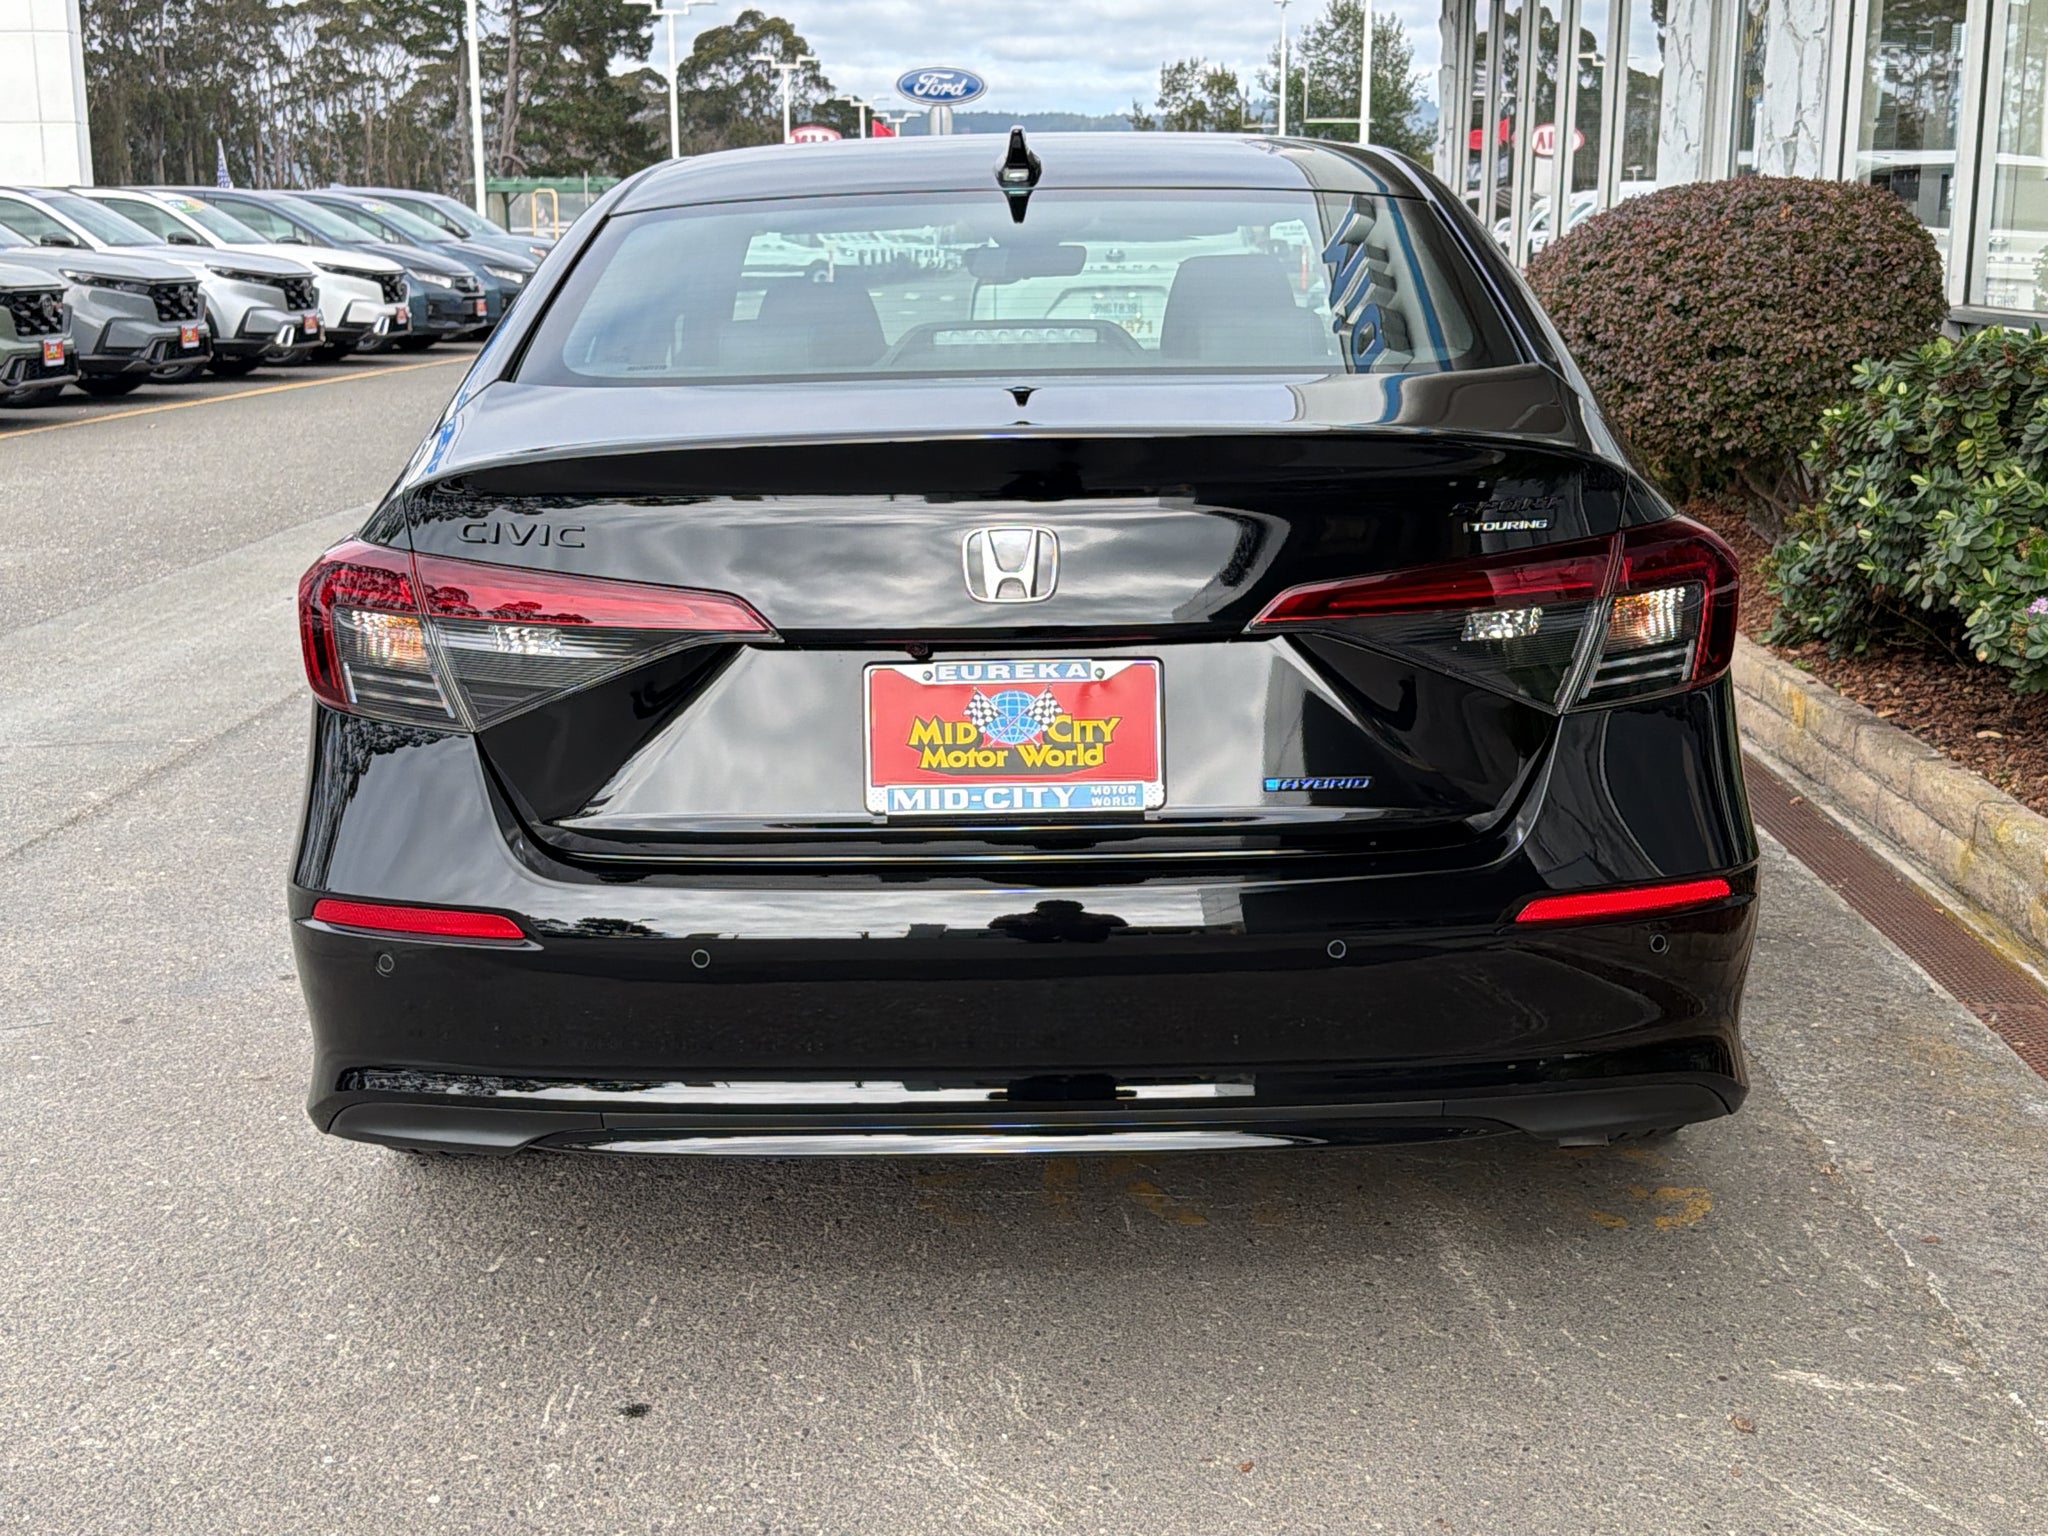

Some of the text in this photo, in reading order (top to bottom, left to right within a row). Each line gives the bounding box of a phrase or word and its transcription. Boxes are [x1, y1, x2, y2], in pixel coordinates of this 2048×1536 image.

[913, 72, 967, 97] Ford
[1470, 519, 1548, 532] TOURING
[457, 521, 585, 548] CIVIC
[938, 663, 1088, 680] EUREKA
[920, 742, 1105, 769] Motor World
[1091, 785, 1137, 796] MOTOR
[1280, 778, 1370, 790] HYBRID
[892, 785, 1079, 811] MID-CITY
[1091, 796, 1137, 806] WORLD
